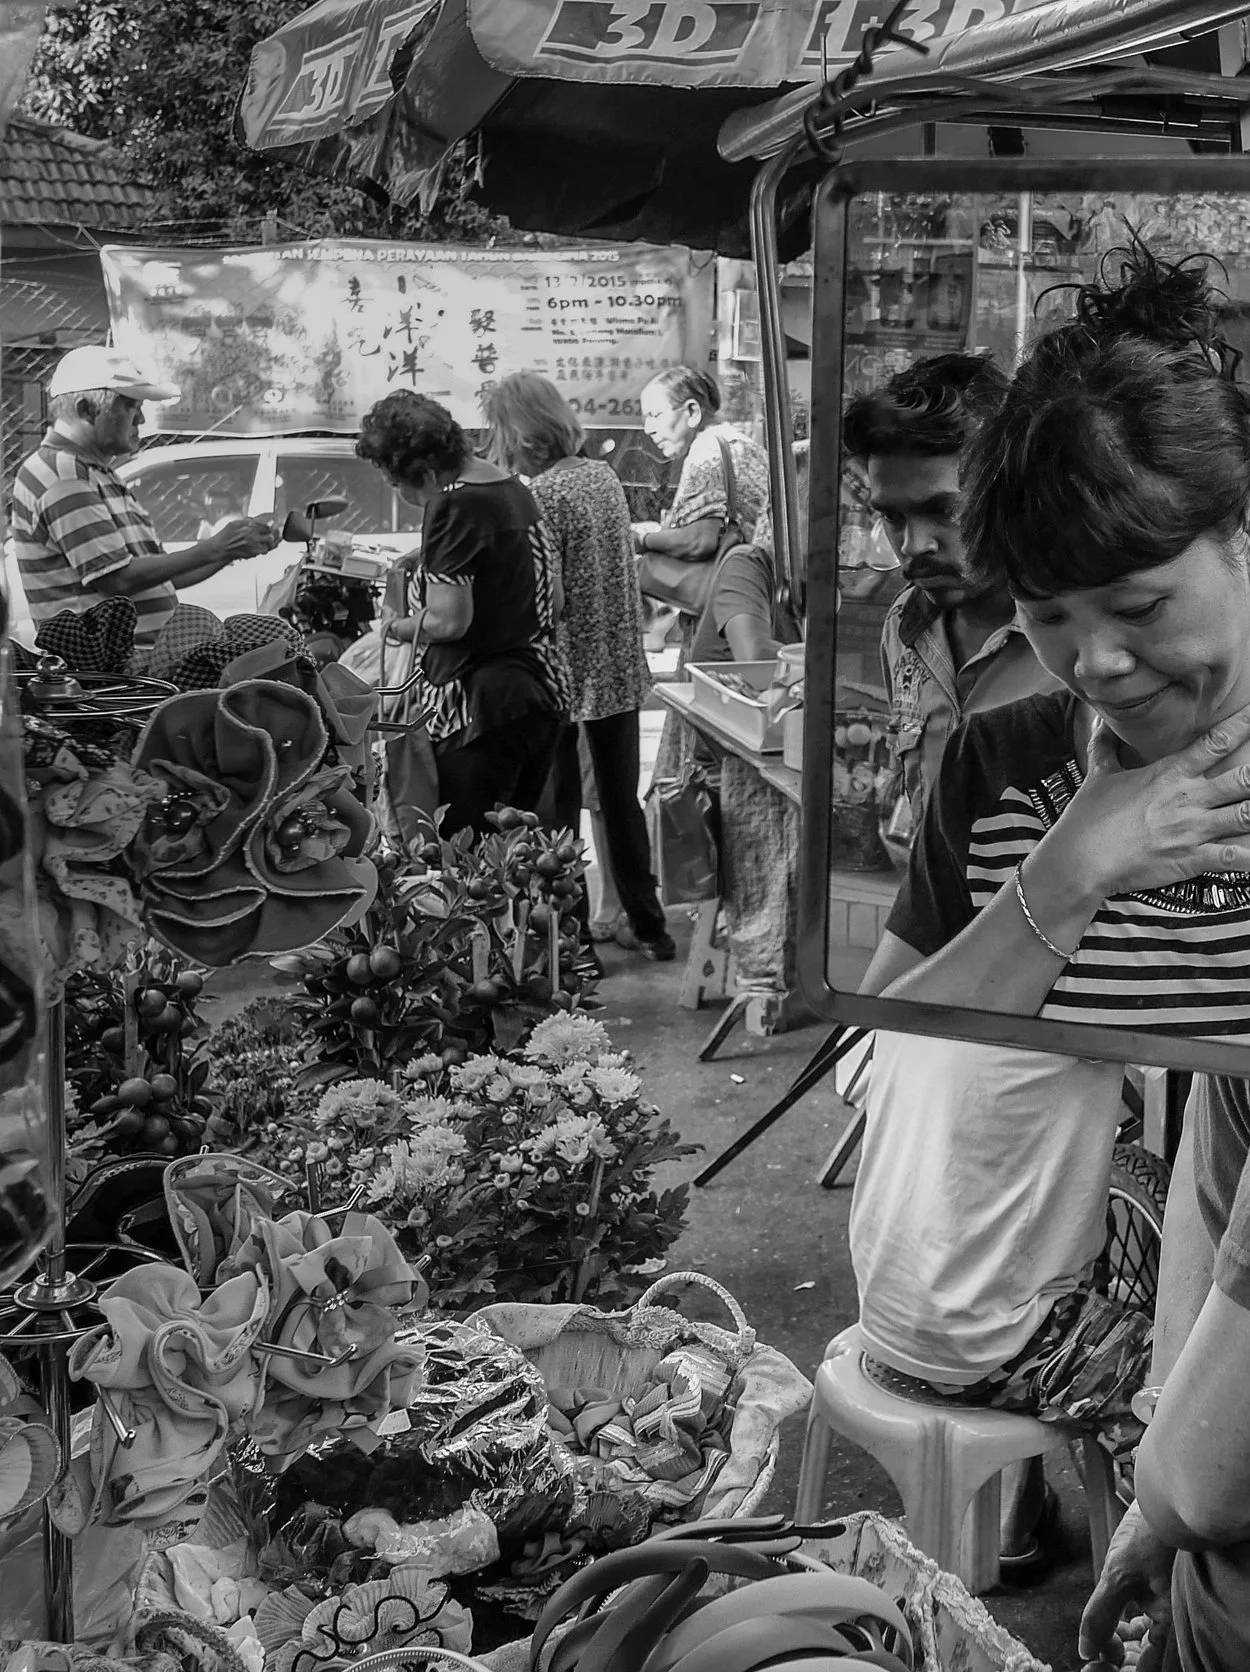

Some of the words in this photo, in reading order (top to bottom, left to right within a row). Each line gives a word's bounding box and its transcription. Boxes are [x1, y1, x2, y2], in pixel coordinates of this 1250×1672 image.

[597, 0, 718, 54] 3D
[301, 53, 345, 114] 3D
[547, 296, 589, 312] 6pm
[607, 293, 684, 309] 10.30pm
